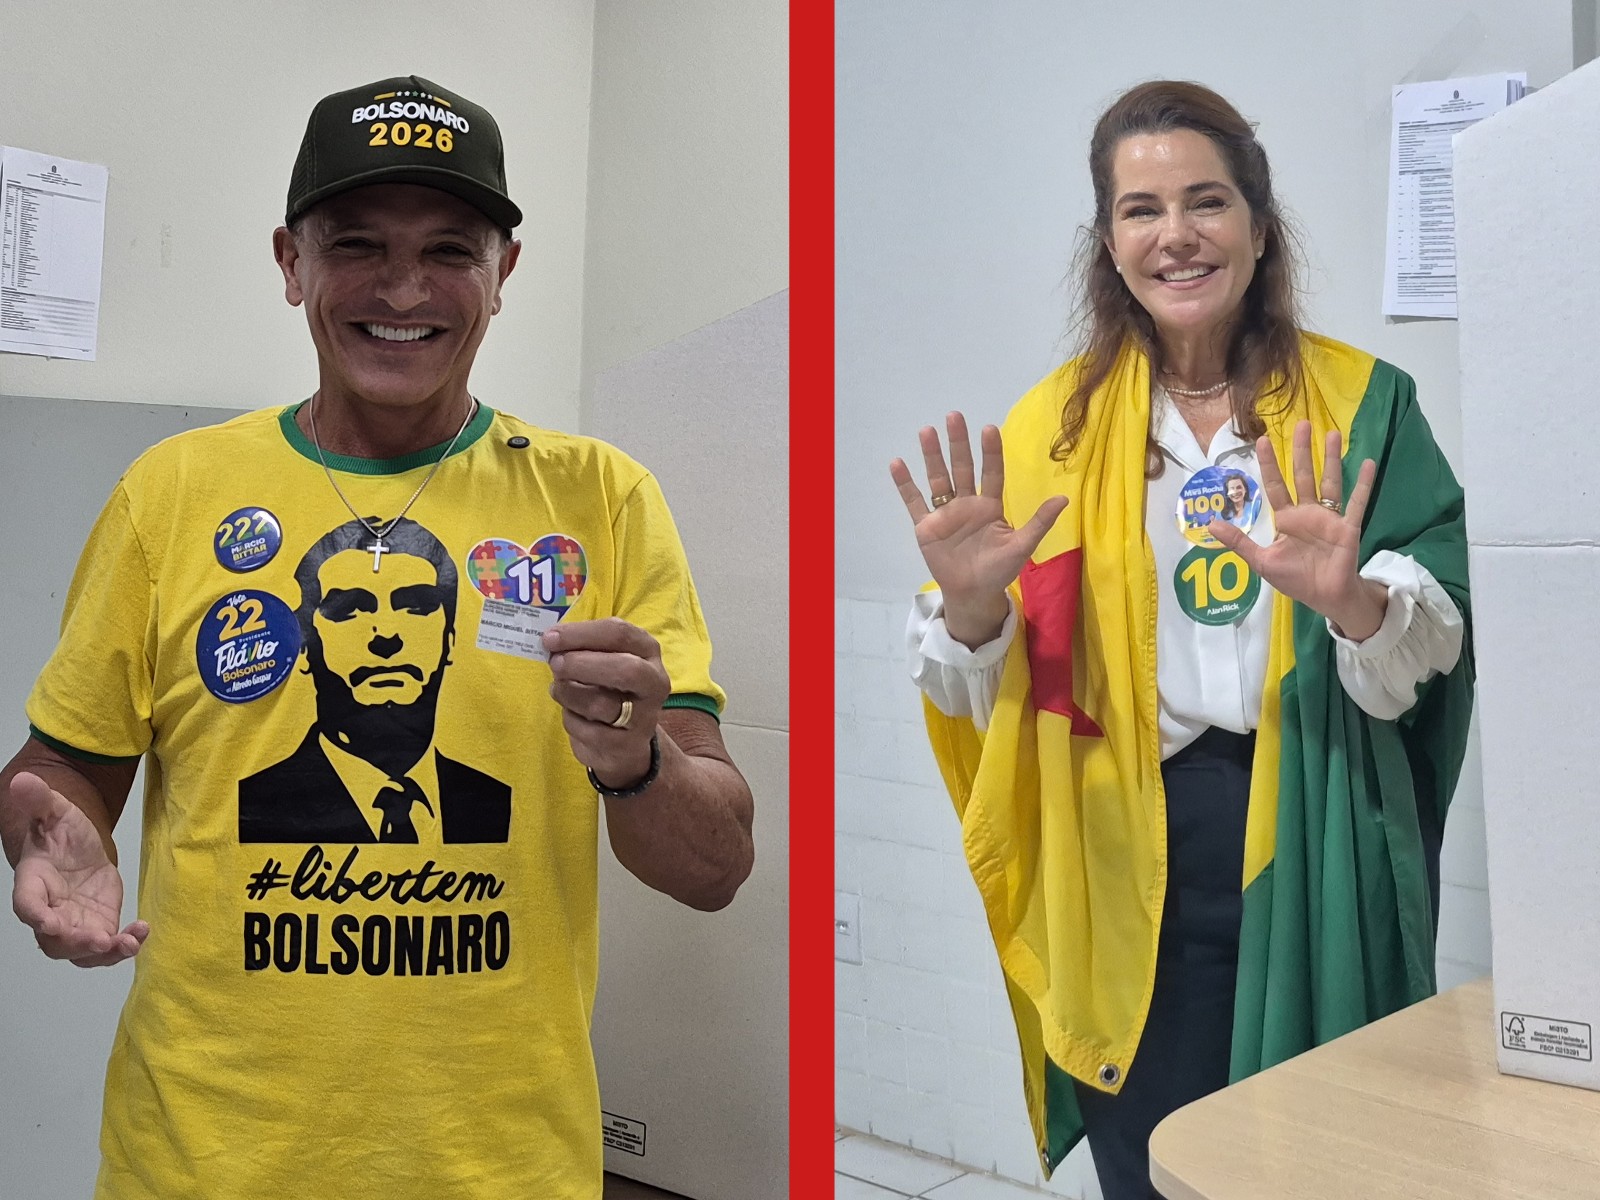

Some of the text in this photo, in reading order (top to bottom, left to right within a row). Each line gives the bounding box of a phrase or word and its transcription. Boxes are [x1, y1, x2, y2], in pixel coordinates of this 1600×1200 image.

[352, 101, 470, 134] BOLSONARO
[369, 121, 453, 152] 2026
[1184, 493, 1225, 515] 100
[1202, 485, 1224, 494] Rocha
[217, 511, 271, 548] 222
[233, 544, 267, 561] BITTAR
[506, 557, 554, 604] 11
[1181, 551, 1249, 609] 10
[216, 598, 266, 642] 22
[214, 639, 279, 677] Flávio
[223, 659, 276, 683] Bolsonaro
[246, 845, 505, 905] #libertem
[244, 911, 510, 977] BOLSONARO
